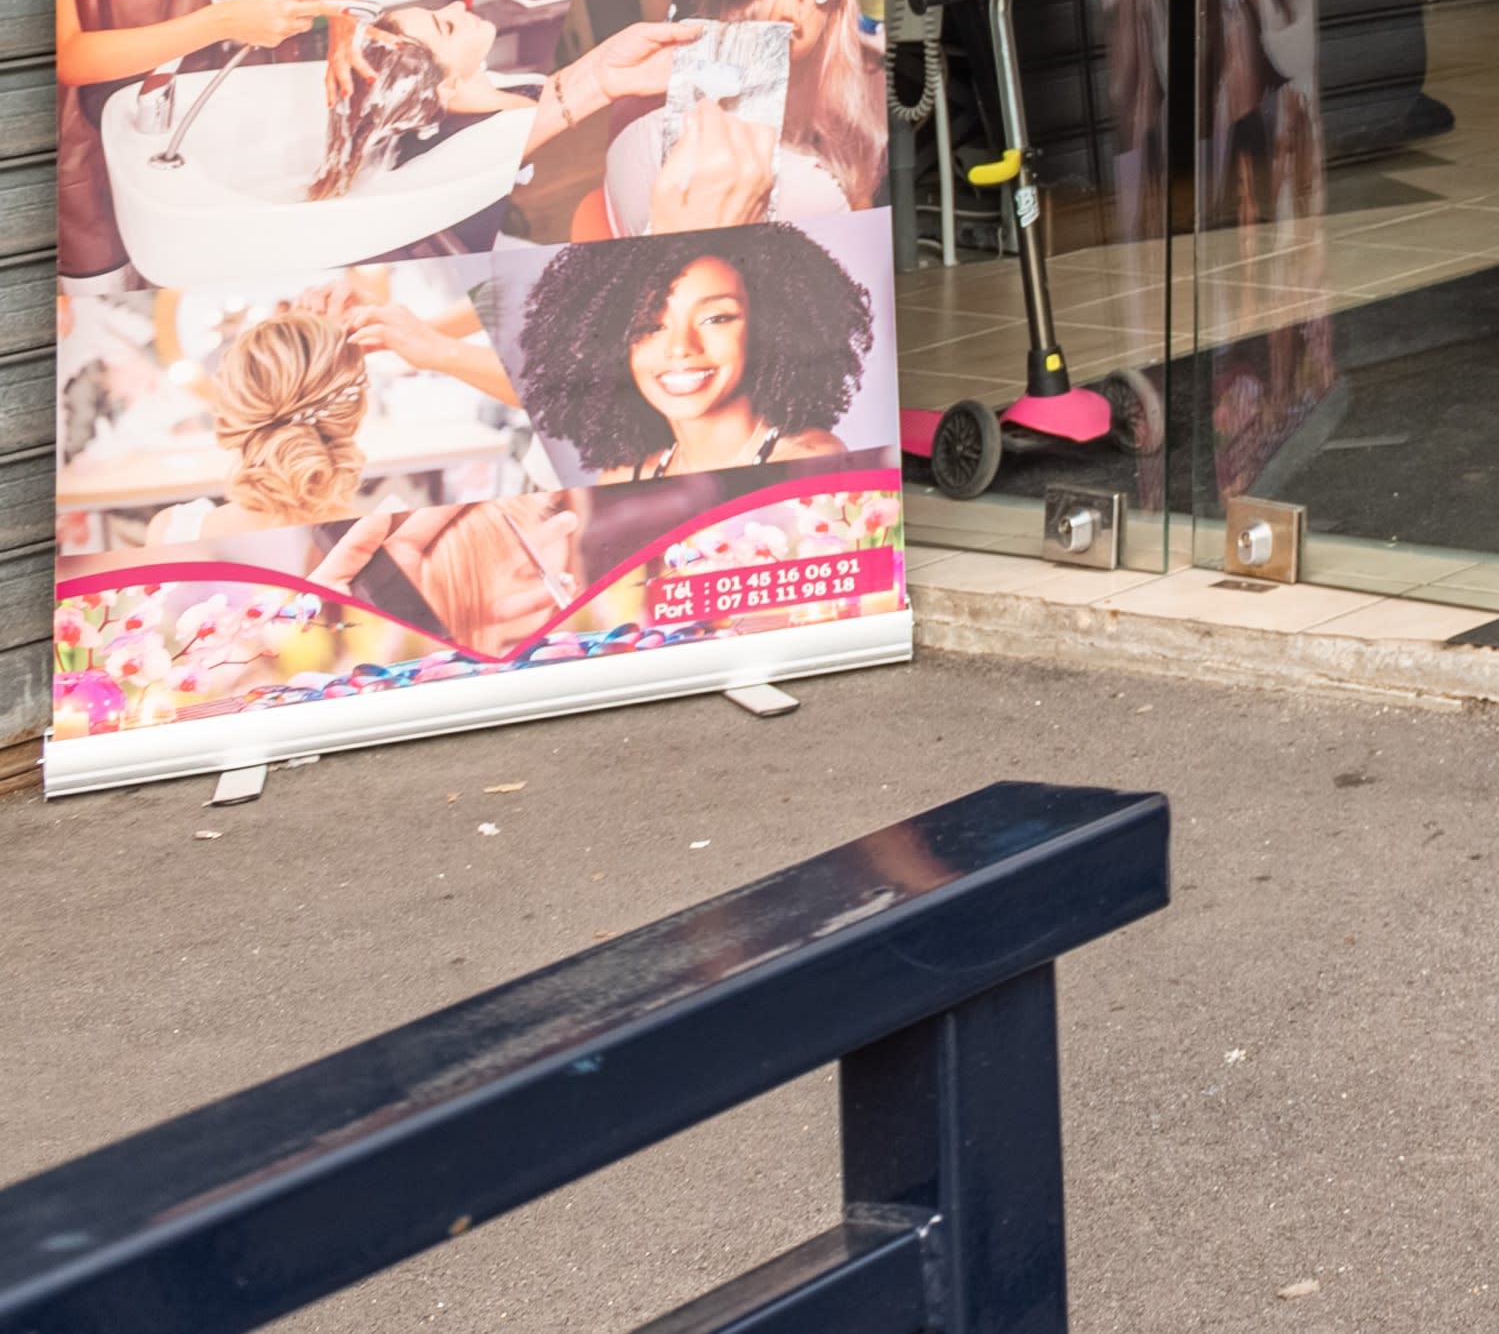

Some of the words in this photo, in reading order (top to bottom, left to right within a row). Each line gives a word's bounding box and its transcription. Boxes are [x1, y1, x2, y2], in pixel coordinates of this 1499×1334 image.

[654, 603, 694, 620] Port
[716, 595, 740, 611] 07
[747, 589, 769, 607] 51
[775, 586, 796, 602] 11
[801, 581, 826, 598] 98
[832, 576, 855, 593] 18
[662, 583, 693, 601] Tél
[716, 577, 741, 593] 01
[747, 572, 772, 588] 45
[777, 567, 800, 584] 16
[805, 563, 832, 580] 06
[836, 558, 861, 575] 91
